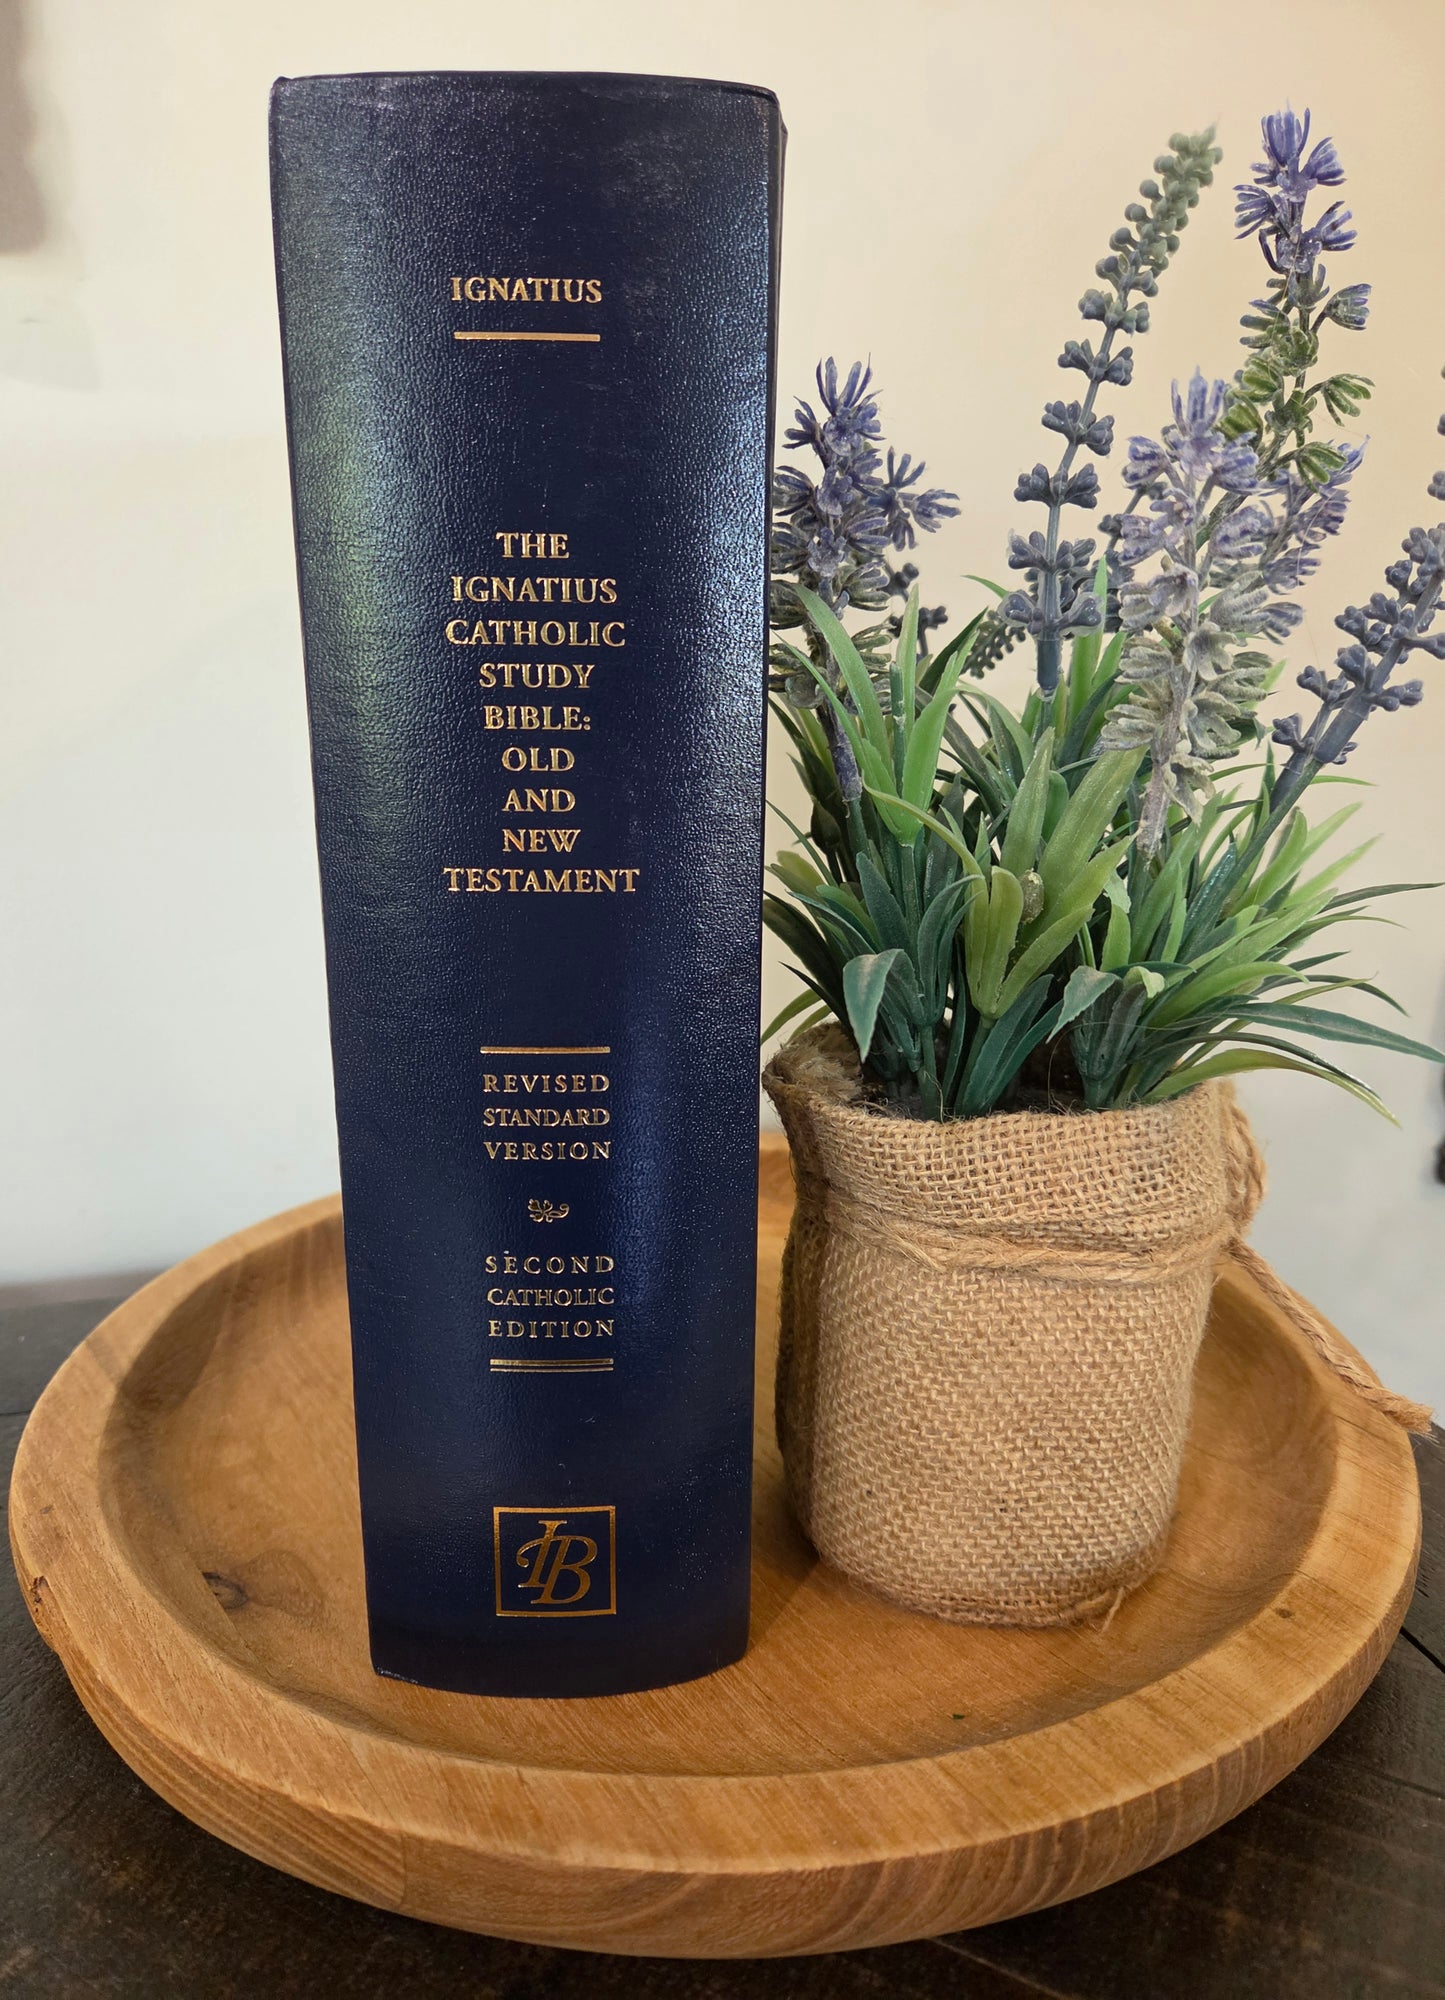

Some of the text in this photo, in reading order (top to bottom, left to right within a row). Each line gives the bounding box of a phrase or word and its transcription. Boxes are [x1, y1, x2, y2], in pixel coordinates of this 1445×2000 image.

[450, 276, 603, 304] IGNATIUS
[496, 532, 570, 559] THE
[451, 576, 618, 604] IGNATIUS
[445, 619, 626, 647] CATHOLIC
[479, 663, 595, 689] STUDY
[484, 705, 592, 730] BIBLE:
[501, 746, 575, 772] OLD
[501, 788, 576, 812] AND
[502, 828, 581, 853] NEW
[443, 867, 640, 893] TESTAMENT
[483, 1074, 610, 1093] REVISED
[483, 1108, 611, 1127] STANDARD
[483, 1141, 612, 1161] VERSION
[485, 1255, 615, 1274] SECOND
[487, 1287, 614, 1307] CATHOLIC
[488, 1319, 614, 1339] EDITION
